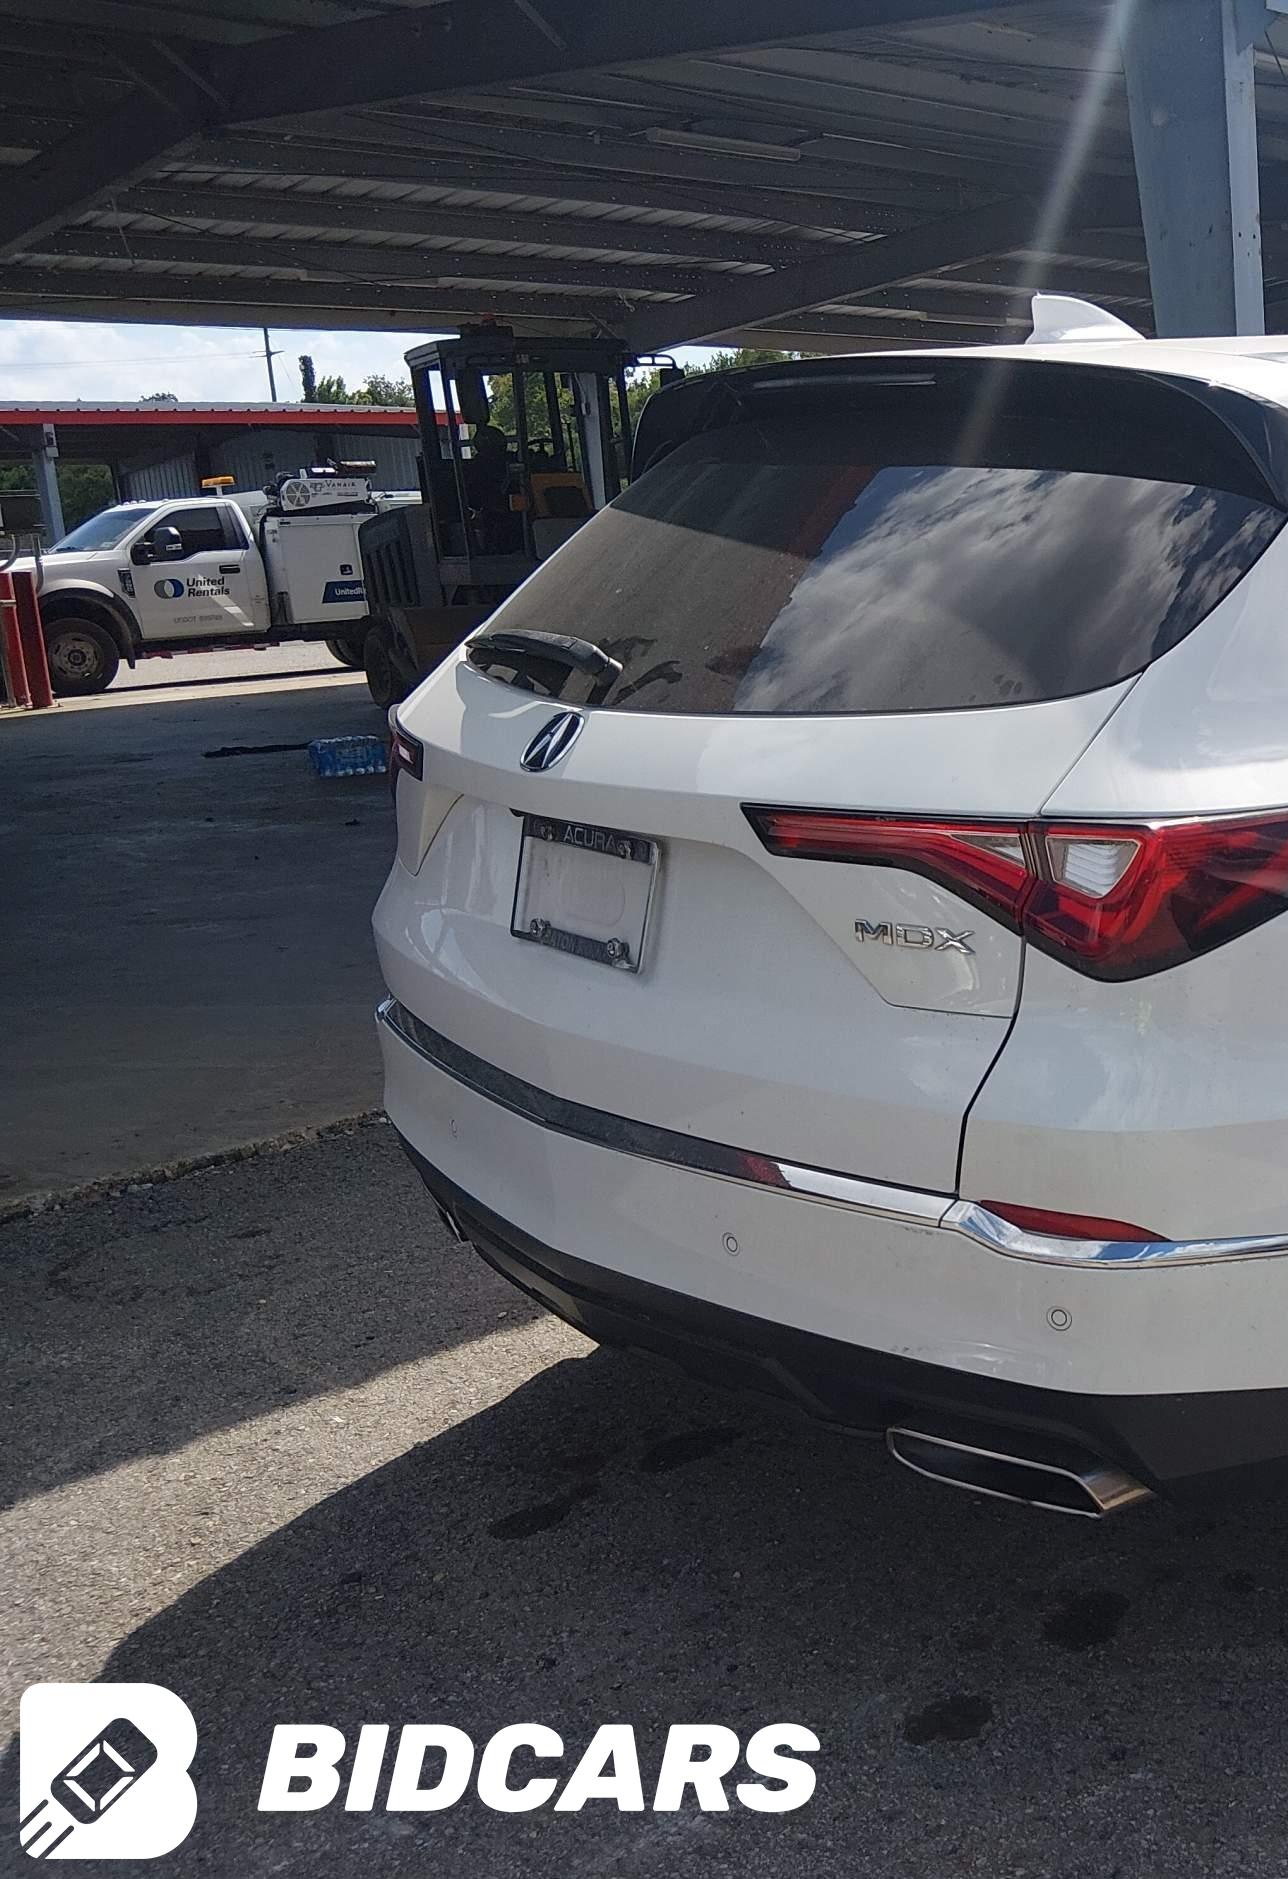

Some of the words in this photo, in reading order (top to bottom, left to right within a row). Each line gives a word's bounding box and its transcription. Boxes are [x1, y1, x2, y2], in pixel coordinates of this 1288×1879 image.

[186, 576, 225, 587] United
[187, 587, 230, 597] Rentals
[563, 825, 617, 849] ACURA
[854, 918, 977, 955] MDX
